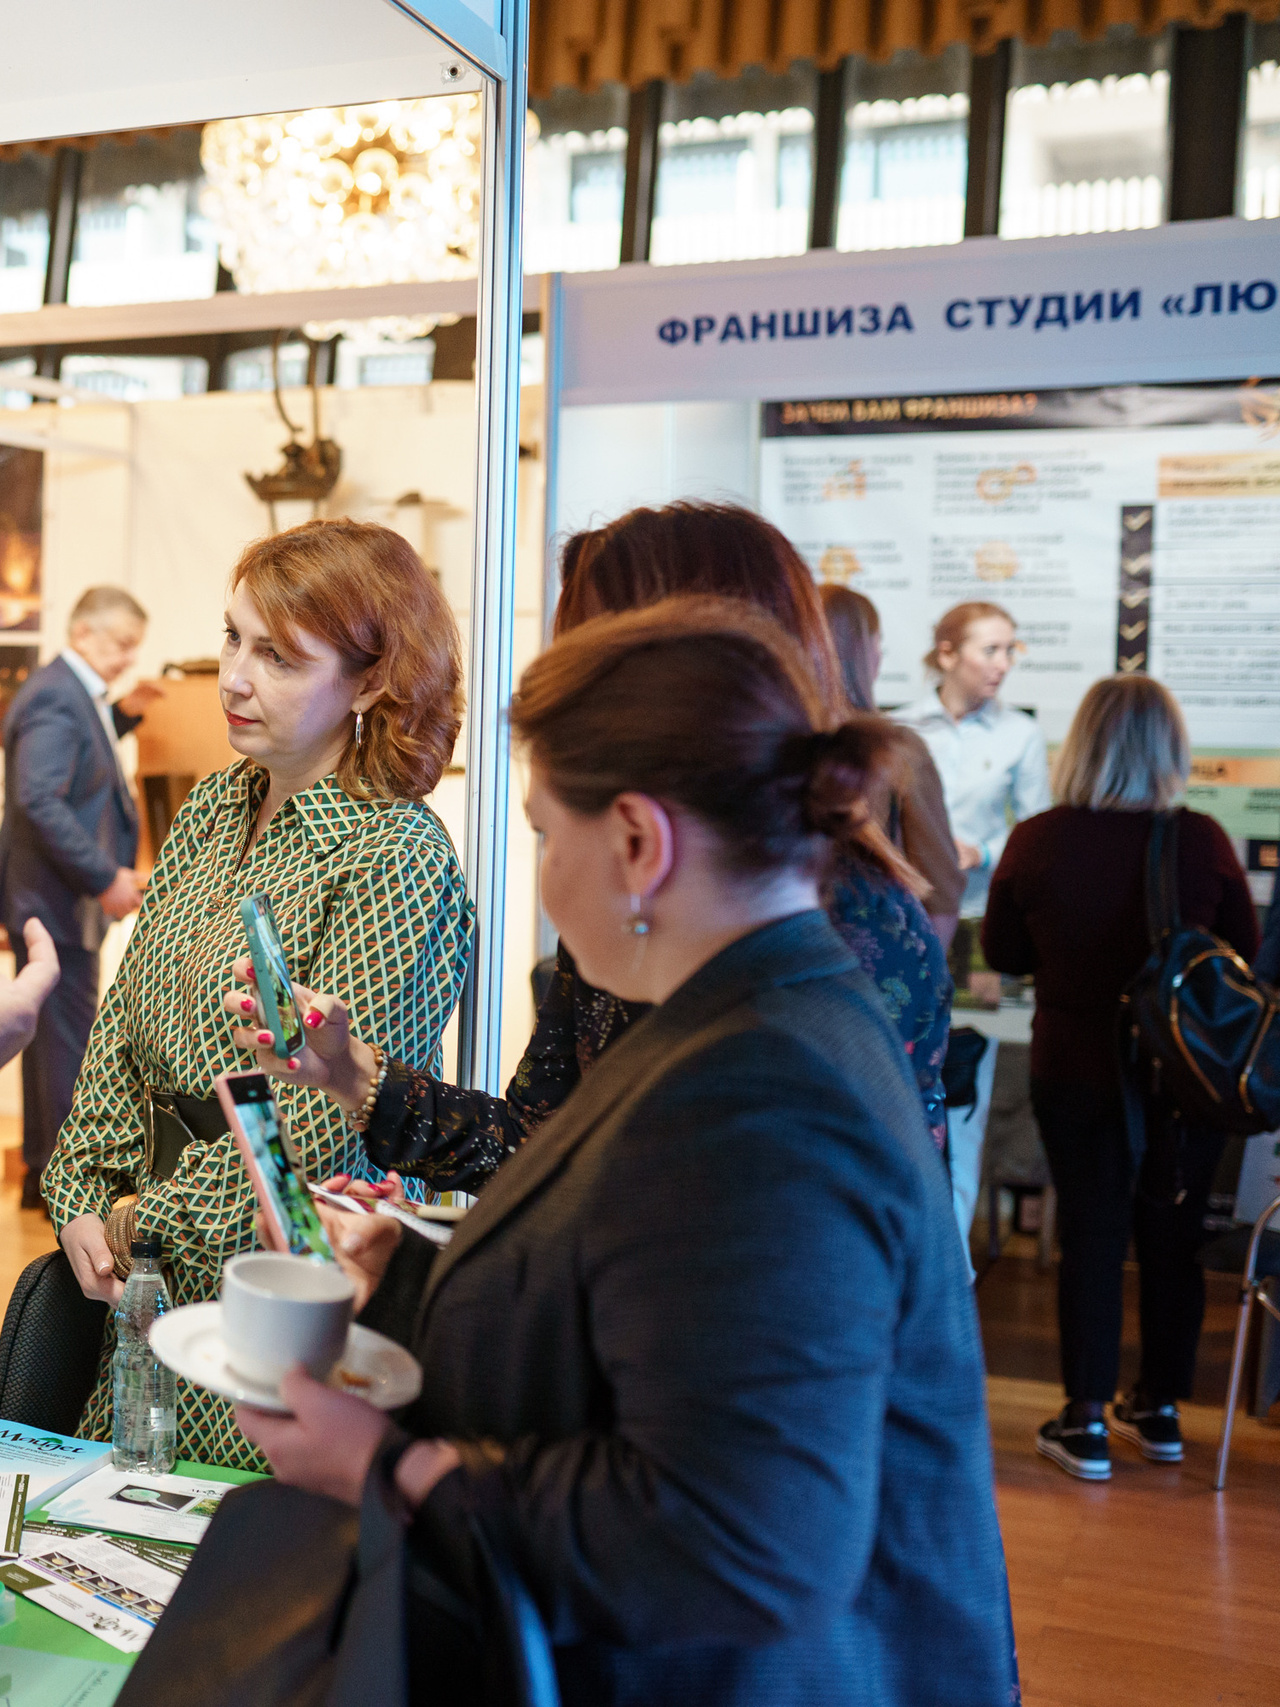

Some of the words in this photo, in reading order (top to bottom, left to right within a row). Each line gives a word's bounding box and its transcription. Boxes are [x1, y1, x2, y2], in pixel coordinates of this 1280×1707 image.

[658, 304, 915, 346] ФРАНШИЗА
[945, 289, 1143, 331] СТУДИИ
[781, 401, 850, 424] ЗАЧЕМ
[852, 399, 901, 422] ВАМ
[902, 393, 1038, 420] ФРАНШИЗА?
